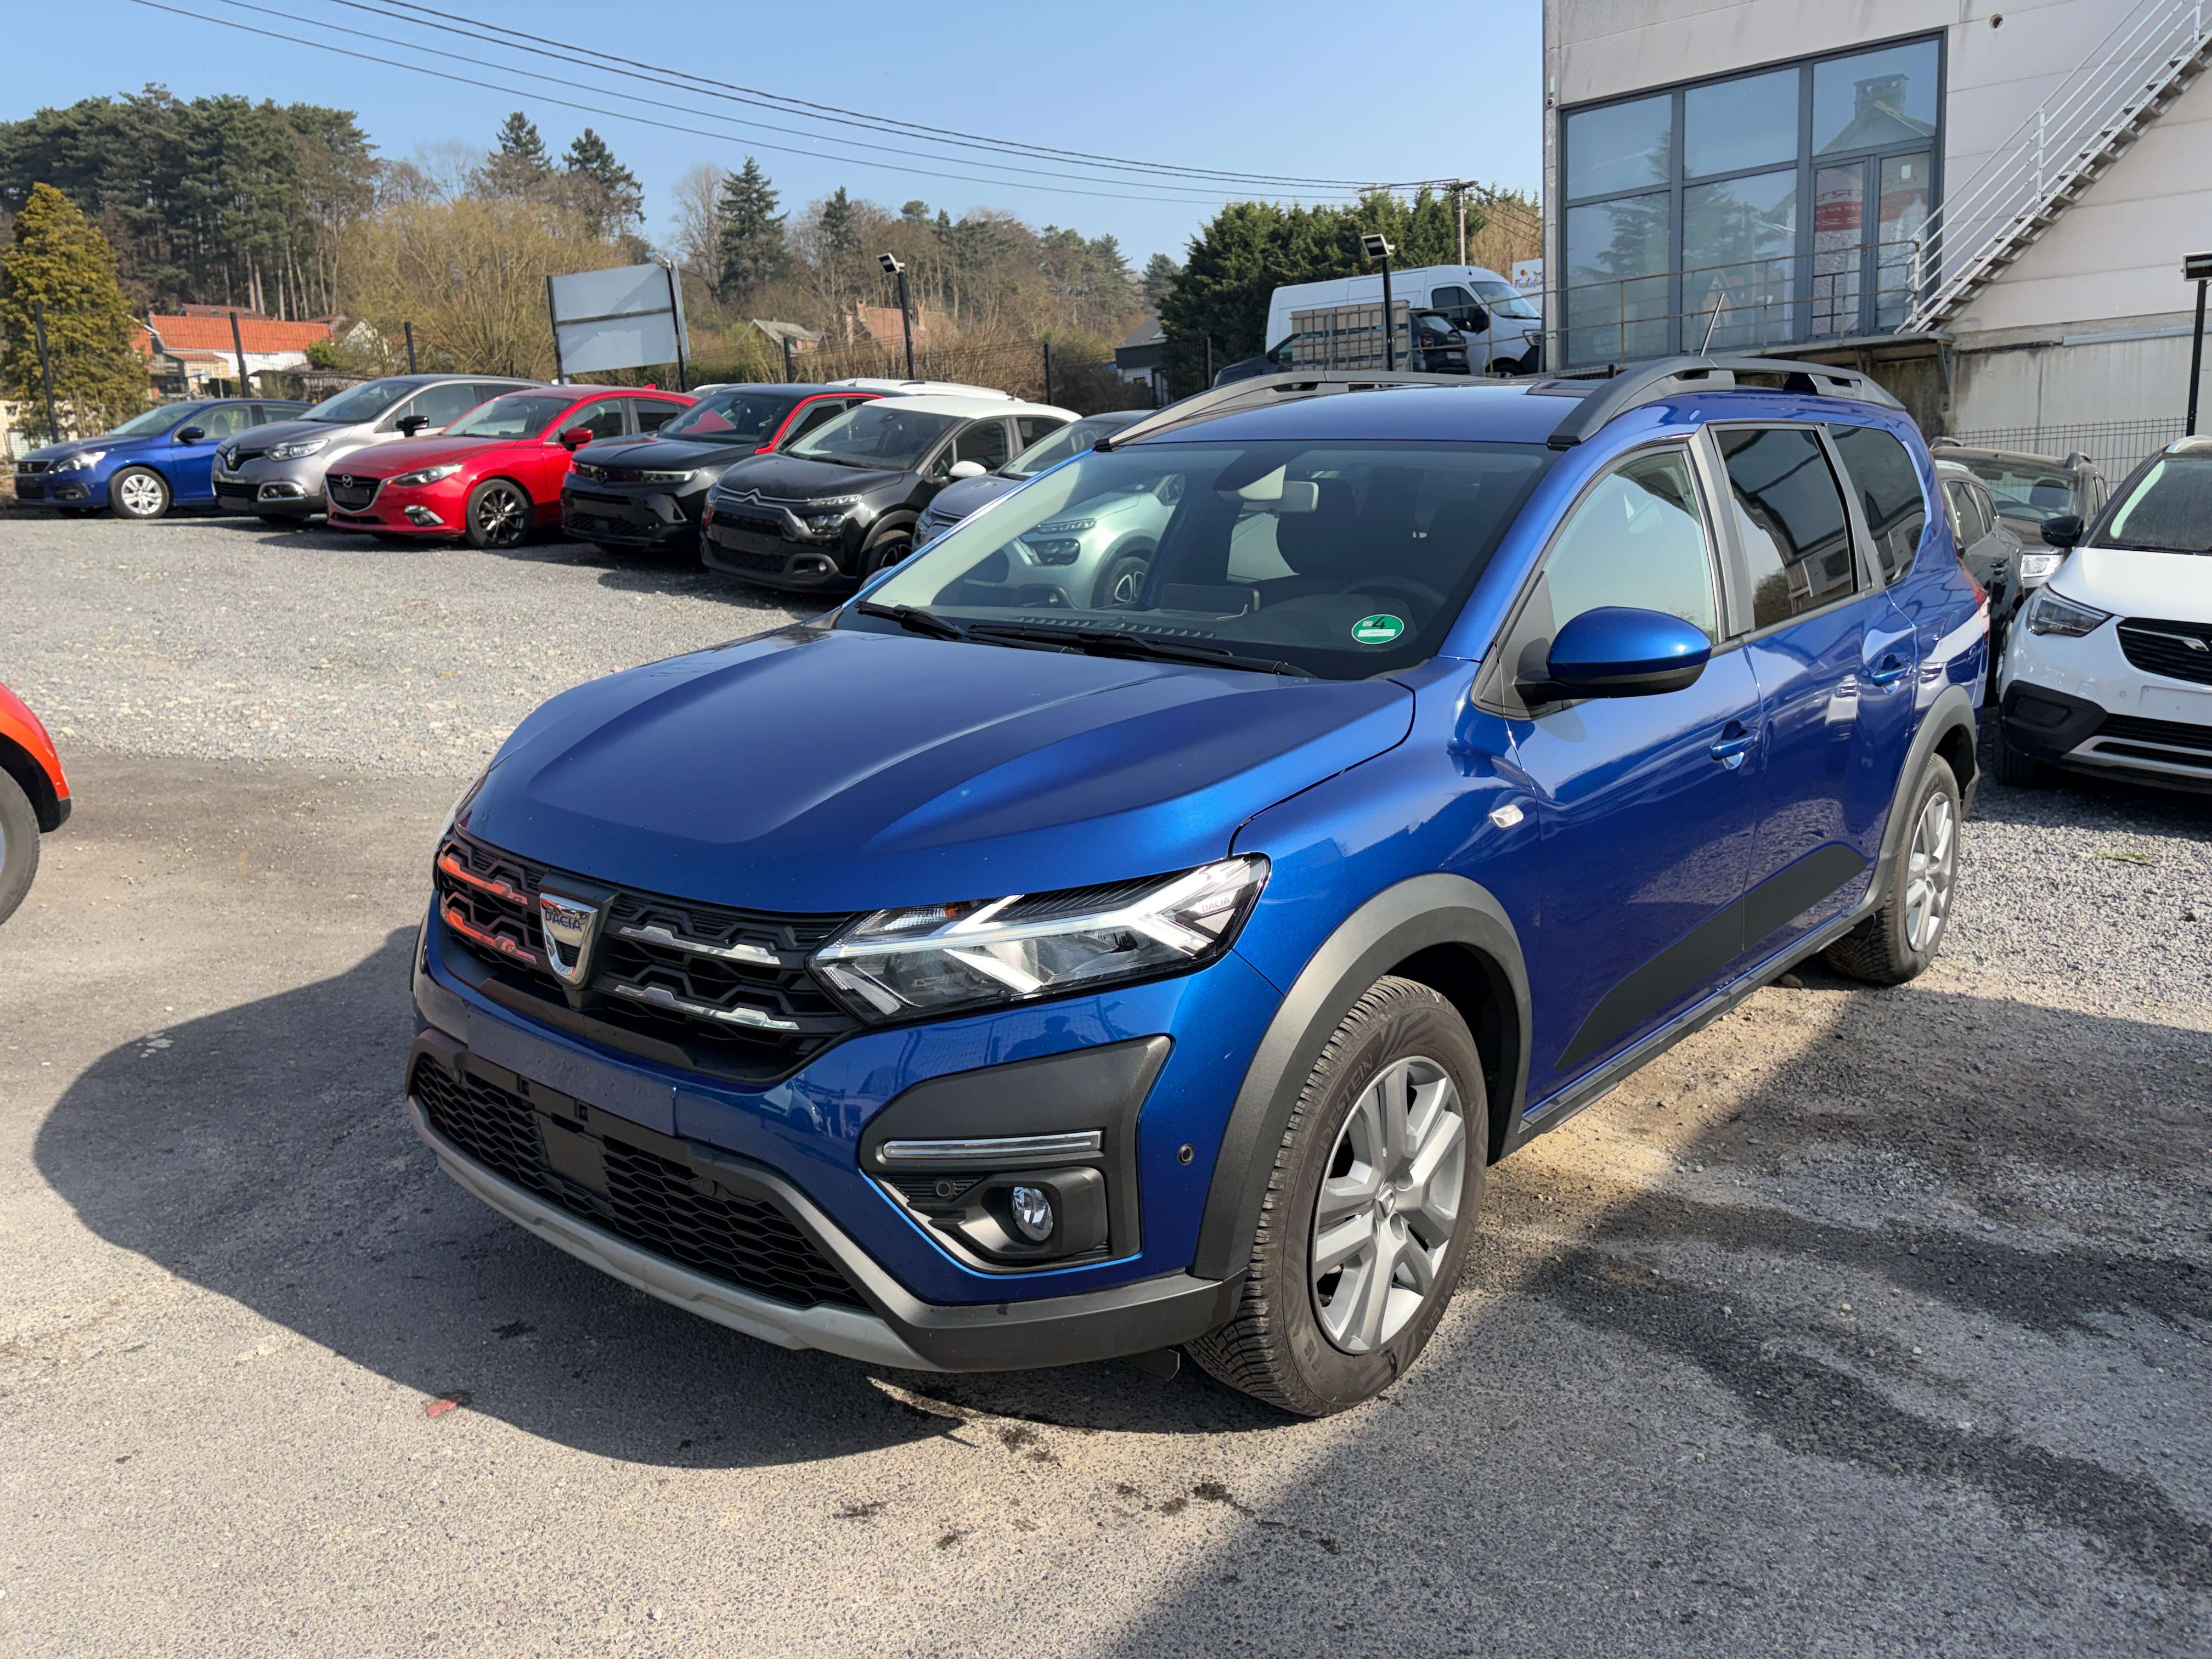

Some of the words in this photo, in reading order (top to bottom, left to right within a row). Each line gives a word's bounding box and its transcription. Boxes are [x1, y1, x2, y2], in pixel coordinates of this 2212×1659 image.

[1372, 616, 1385, 629] 4
[1202, 898, 1230, 912] DACIA
[545, 911, 582, 932] DACIA
